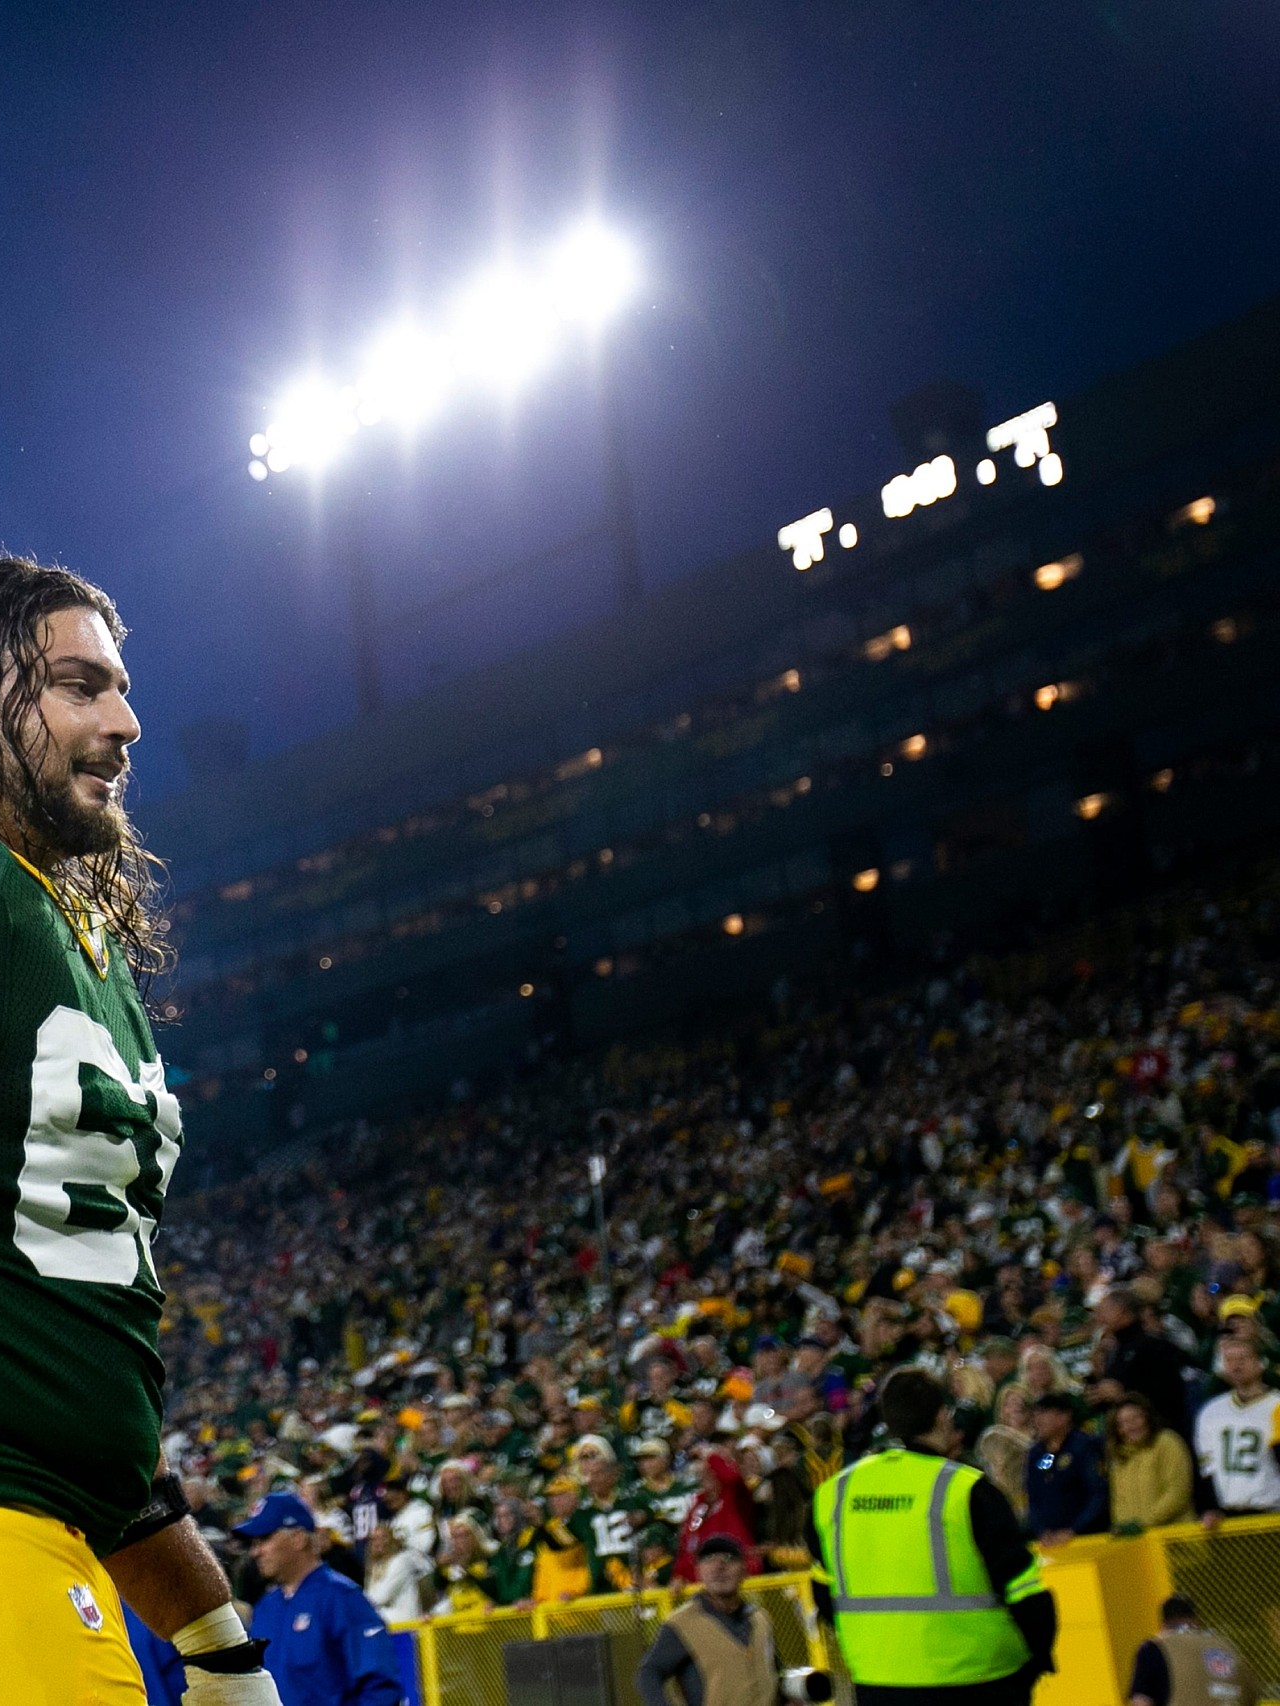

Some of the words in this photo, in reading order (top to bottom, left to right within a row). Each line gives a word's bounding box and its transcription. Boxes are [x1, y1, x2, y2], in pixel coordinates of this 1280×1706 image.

[1221, 1426, 1261, 1474] 12
[851, 1495, 915, 1511] SECURITY
[590, 1510, 635, 1557] 12
